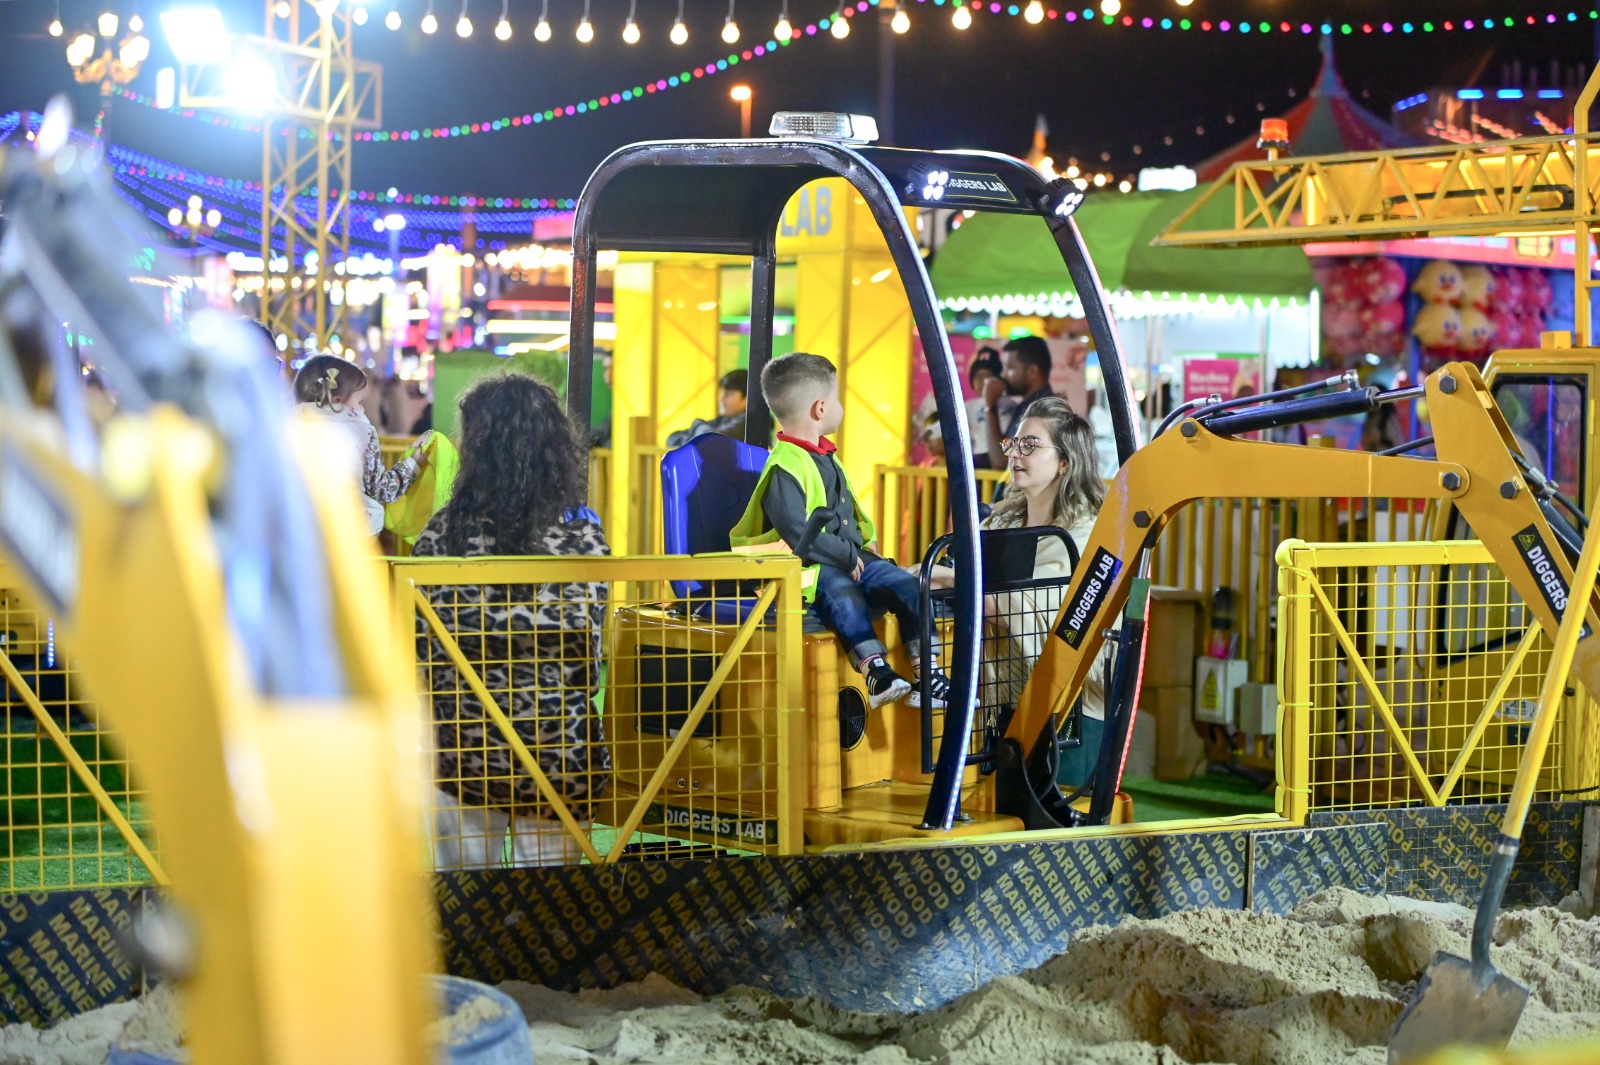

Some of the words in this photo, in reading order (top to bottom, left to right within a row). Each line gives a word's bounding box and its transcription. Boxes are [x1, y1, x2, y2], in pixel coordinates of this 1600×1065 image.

[1069, 578, 1102, 631] DIGGERS
[1095, 554, 1115, 581] LAB
[1527, 545, 1568, 611] DIGGERS
[664, 809, 731, 834] DIGGERS
[735, 820, 764, 840] LAB
[536, 868, 595, 945] LYWOOD
[996, 872, 1045, 945] MARINE
[1012, 858, 1060, 931] MARINE
[1028, 845, 1077, 917] MARINE
[27, 929, 97, 1013] MARINE
[49, 912, 117, 999] MARINE
[69, 896, 132, 981] MARINE
